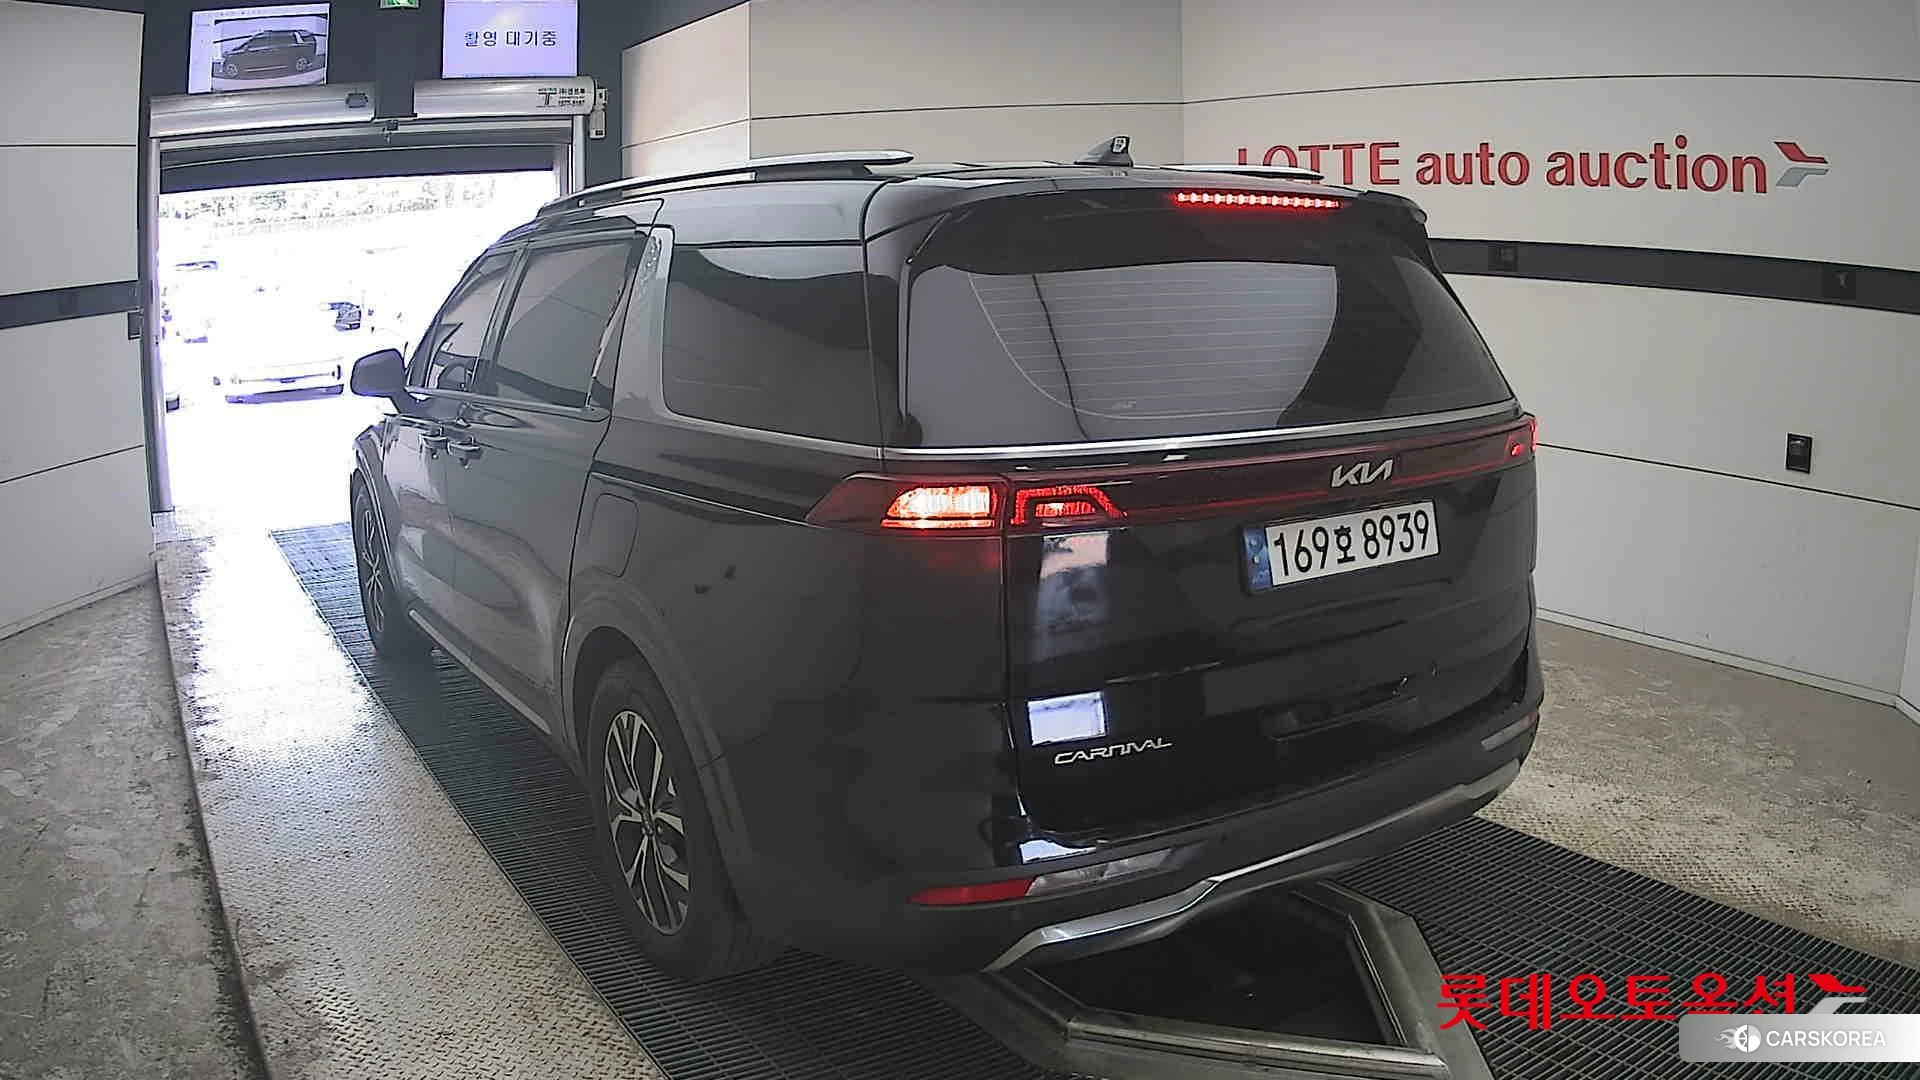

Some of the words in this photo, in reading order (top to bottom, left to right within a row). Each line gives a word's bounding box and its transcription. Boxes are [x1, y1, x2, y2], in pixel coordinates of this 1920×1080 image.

[506, 30, 559, 47] 대기중
[1415, 142, 1531, 186] auto
[1545, 134, 1768, 194] auction
[1330, 459, 1394, 488] KIA
[1273, 525, 1356, 577] 169호
[1361, 509, 1430, 560] 8939
[1054, 737, 1174, 765] CARNIVAL
